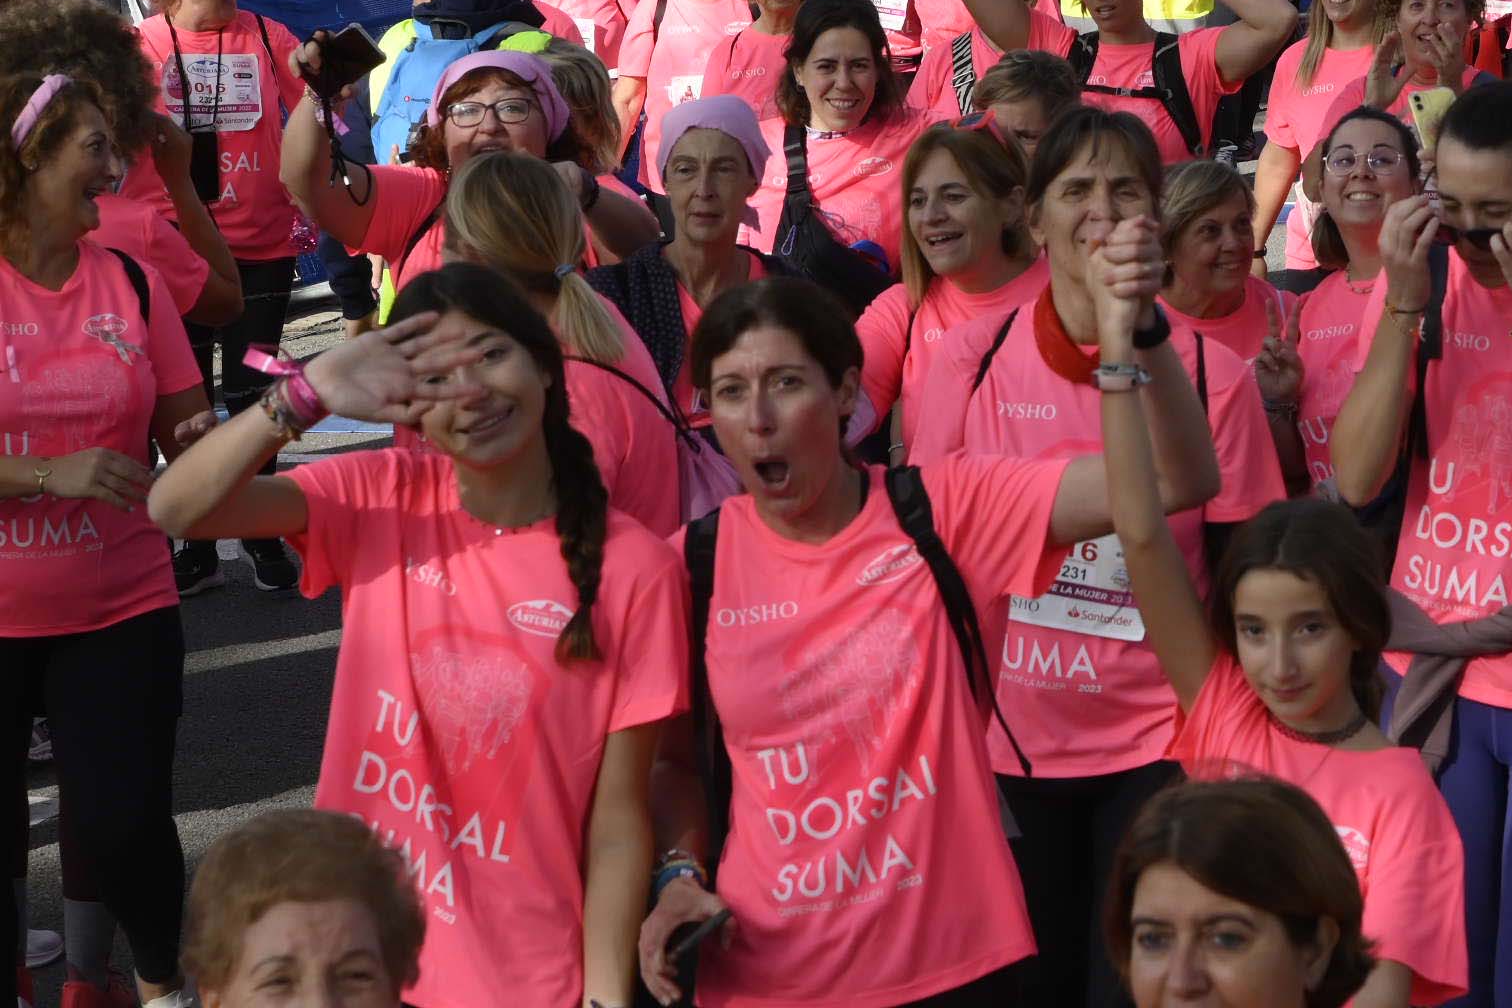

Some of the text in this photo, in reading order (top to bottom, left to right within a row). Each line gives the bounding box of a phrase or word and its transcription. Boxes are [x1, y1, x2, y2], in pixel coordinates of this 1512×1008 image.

[1306, 323, 1354, 341] OYSHO
[1403, 554, 1508, 607] SUMA
[716, 600, 799, 628] OYSHO
[374, 689, 419, 746] TU
[757, 741, 810, 790] TU
[772, 834, 913, 903] SUMA
